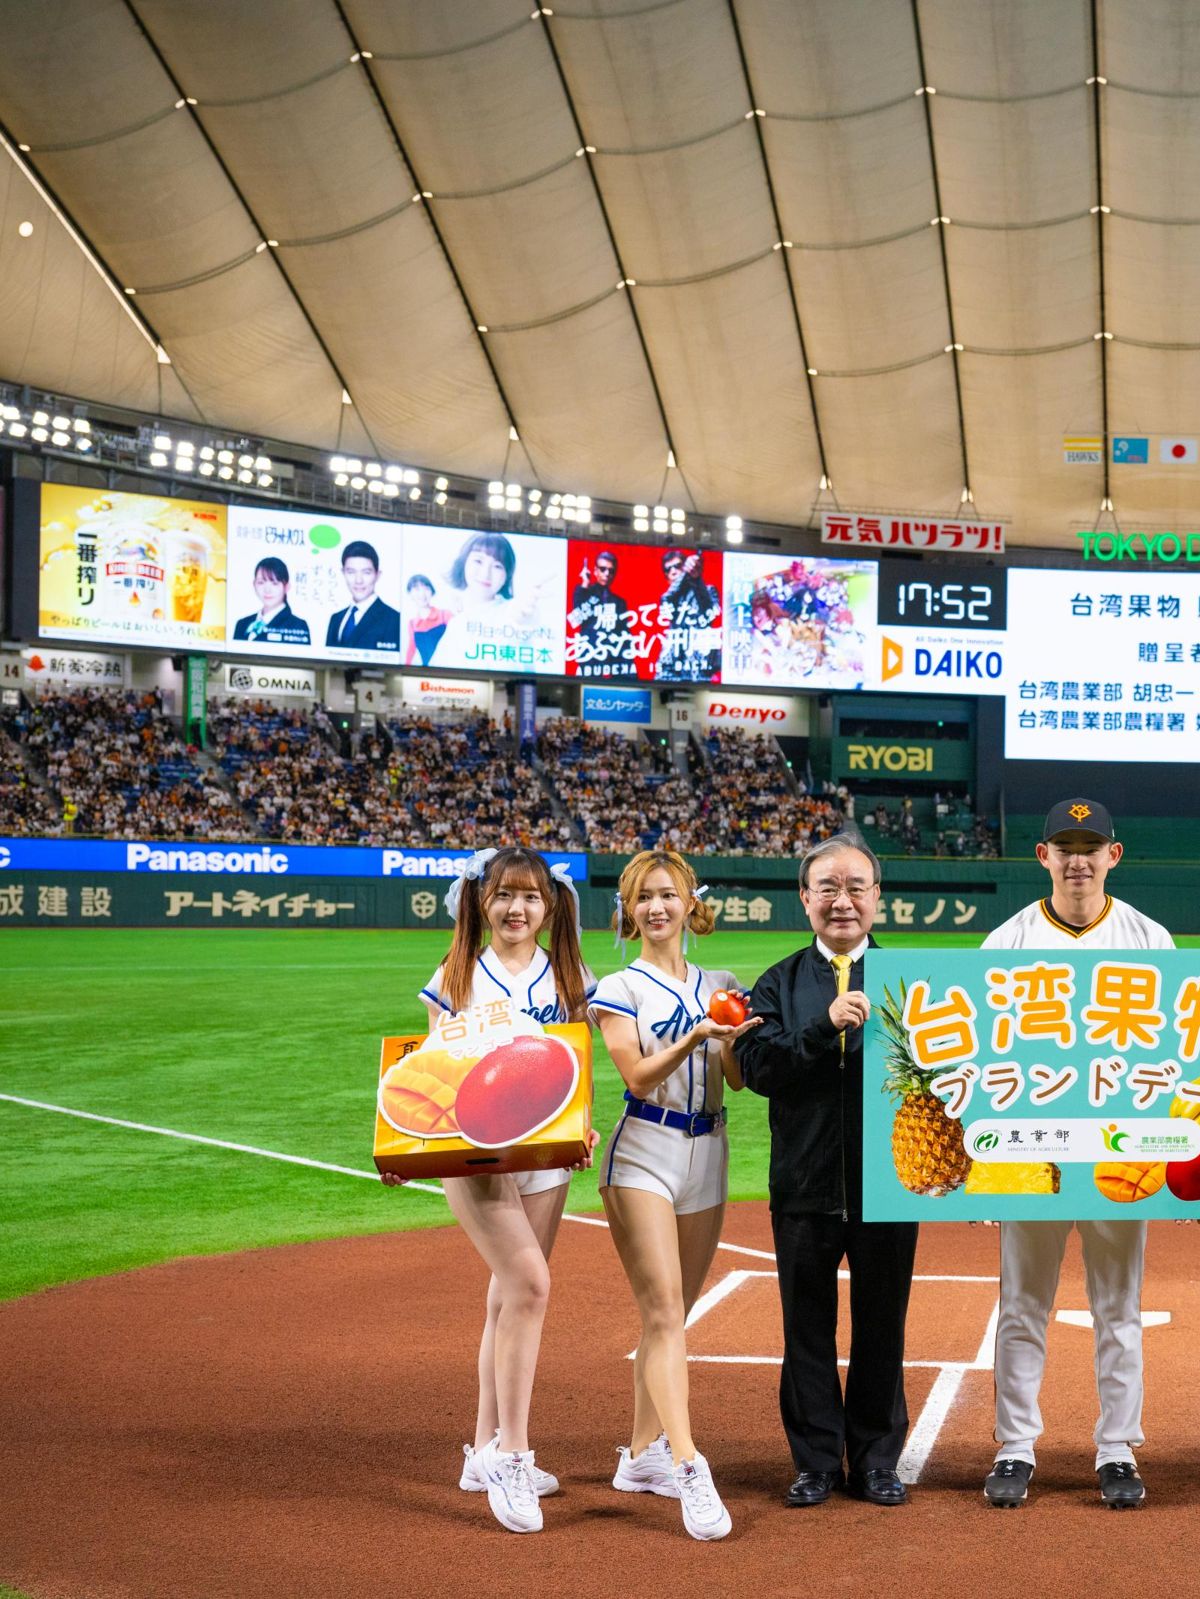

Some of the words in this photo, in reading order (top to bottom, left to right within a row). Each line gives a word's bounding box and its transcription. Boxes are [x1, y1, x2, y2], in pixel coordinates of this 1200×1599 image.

[826, 516, 1002, 550] 元気ハツラツ!
[1076, 532, 1181, 561] TOKYO
[77, 533, 98, 606] 一番搾り
[593, 602, 697, 631] 帰ってきた
[898, 583, 992, 621] 17:52
[1070, 593, 1181, 618] 台湾果物
[465, 643, 553, 665] JR東日本
[565, 628, 722, 663] あぶない刑事
[4, 664, 20, 678] 14
[915, 648, 1003, 679] DAIKO
[258, 676, 312, 692] OMNIA
[1018, 680, 1123, 702] 台湾農業部
[1132, 683, 1194, 702] 胡忠一
[708, 703, 787, 724] Denyo
[1018, 710, 1185, 732] 台湾農業部農糧署
[848, 745, 933, 772] RYOBI
[127, 843, 289, 873] Panasonic
[383, 850, 467, 876] Panas
[164, 889, 354, 918] アートネイチャー
[439, 1000, 512, 1041] 台湾
